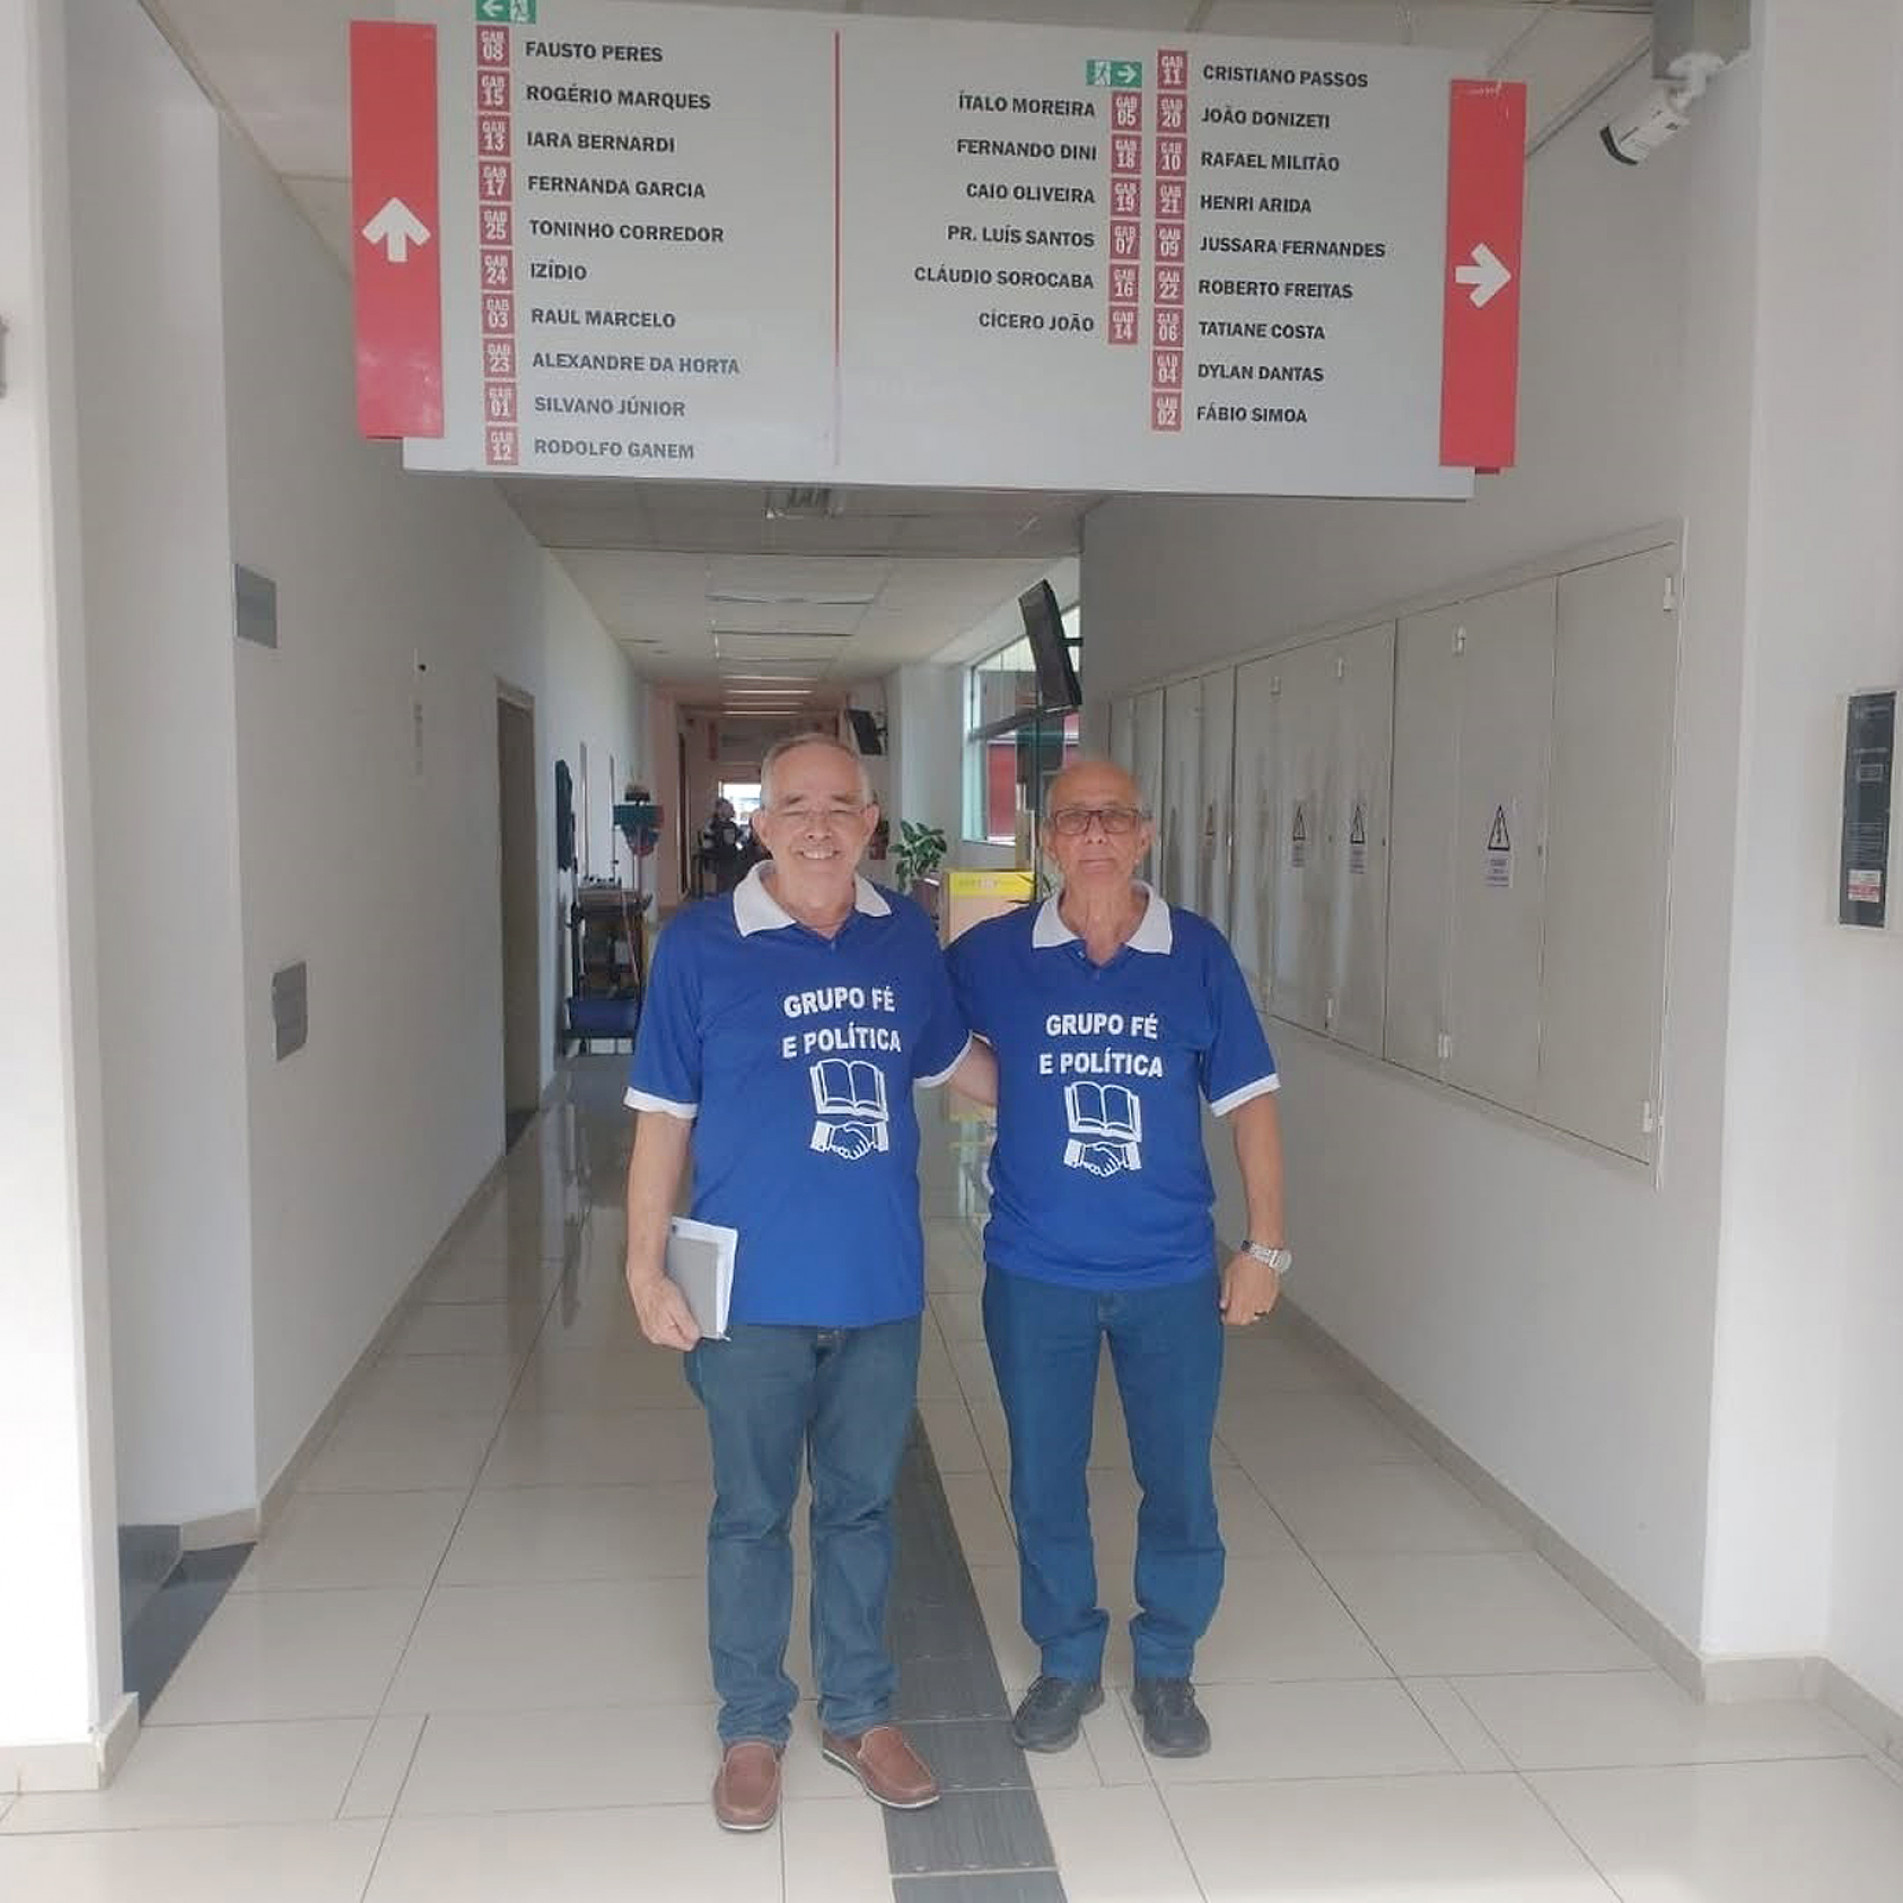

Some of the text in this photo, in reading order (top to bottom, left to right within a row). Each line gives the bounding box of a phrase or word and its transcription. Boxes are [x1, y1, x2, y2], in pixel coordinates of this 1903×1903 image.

[526, 41, 663, 62] FAUSTO PERES
[1163, 69, 1182, 84] 11
[1203, 65, 1368, 87] CRISTIANO PASSOS
[527, 84, 710, 110] ROGÉRIO MARQUES
[960, 90, 1095, 116] ÍTALO MOREIRA
[1117, 111, 1137, 126] 05
[1162, 112, 1181, 128] 20
[1202, 106, 1329, 129] JOÃO DONIZETI
[528, 131, 674, 152] IARA BERNARDI
[957, 139, 1096, 160] FERNANDO DINI
[1161, 155, 1181, 170] 10
[1201, 152, 1339, 171] RAFAEL MILITÃO
[485, 179, 505, 196] 17
[528, 176, 705, 198] FERNANDA GARCIA
[967, 183, 1095, 203] CAIO OLIVEIRA
[1161, 199, 1179, 214] 21
[1201, 195, 1311, 213] HENRI ARIDA
[485, 223, 506, 241] 25
[530, 220, 723, 242] TONINHO CORREDOR
[948, 225, 1094, 247] PR. LUÍS SANTOS
[1115, 239, 1134, 254] 07
[1160, 242, 1179, 257] 09
[1200, 237, 1385, 257] JUSSARA FERNANDES
[487, 267, 507, 285] 24
[531, 260, 587, 280] IZÍDIO
[914, 264, 1093, 289] CLÁUDIO SOROCABA
[1115, 281, 1134, 297] 16
[1160, 284, 1178, 299] 22
[1199, 280, 1353, 298] ROBERTO FREITAS
[488, 311, 509, 328] 03
[532, 308, 676, 328] RAUL MARCELO
[979, 309, 1094, 331] CÍCERO JOÃO
[1114, 323, 1133, 340] 14
[1159, 325, 1178, 341] 06
[1199, 322, 1325, 339] TATIANE COSTA
[489, 356, 510, 373] 23
[533, 352, 739, 374] ALEXANDRE DA HORTA
[1198, 364, 1324, 381] DYLAN DANTAS
[1158, 367, 1177, 384] 04
[535, 396, 685, 416] SILVANO JÚNIOR
[1197, 402, 1307, 423] FÁBIO SIMOA
[1157, 410, 1177, 426] 02
[492, 443, 511, 461] 12
[535, 439, 694, 459] RODOLFO GANEM
[784, 986, 895, 1017] GRUPO FÉ
[1047, 1013, 1158, 1039] GRUPO FÉ
[783, 1022, 901, 1058] E POLÍTICA
[1040, 1047, 1162, 1077] E POLÍTICA
